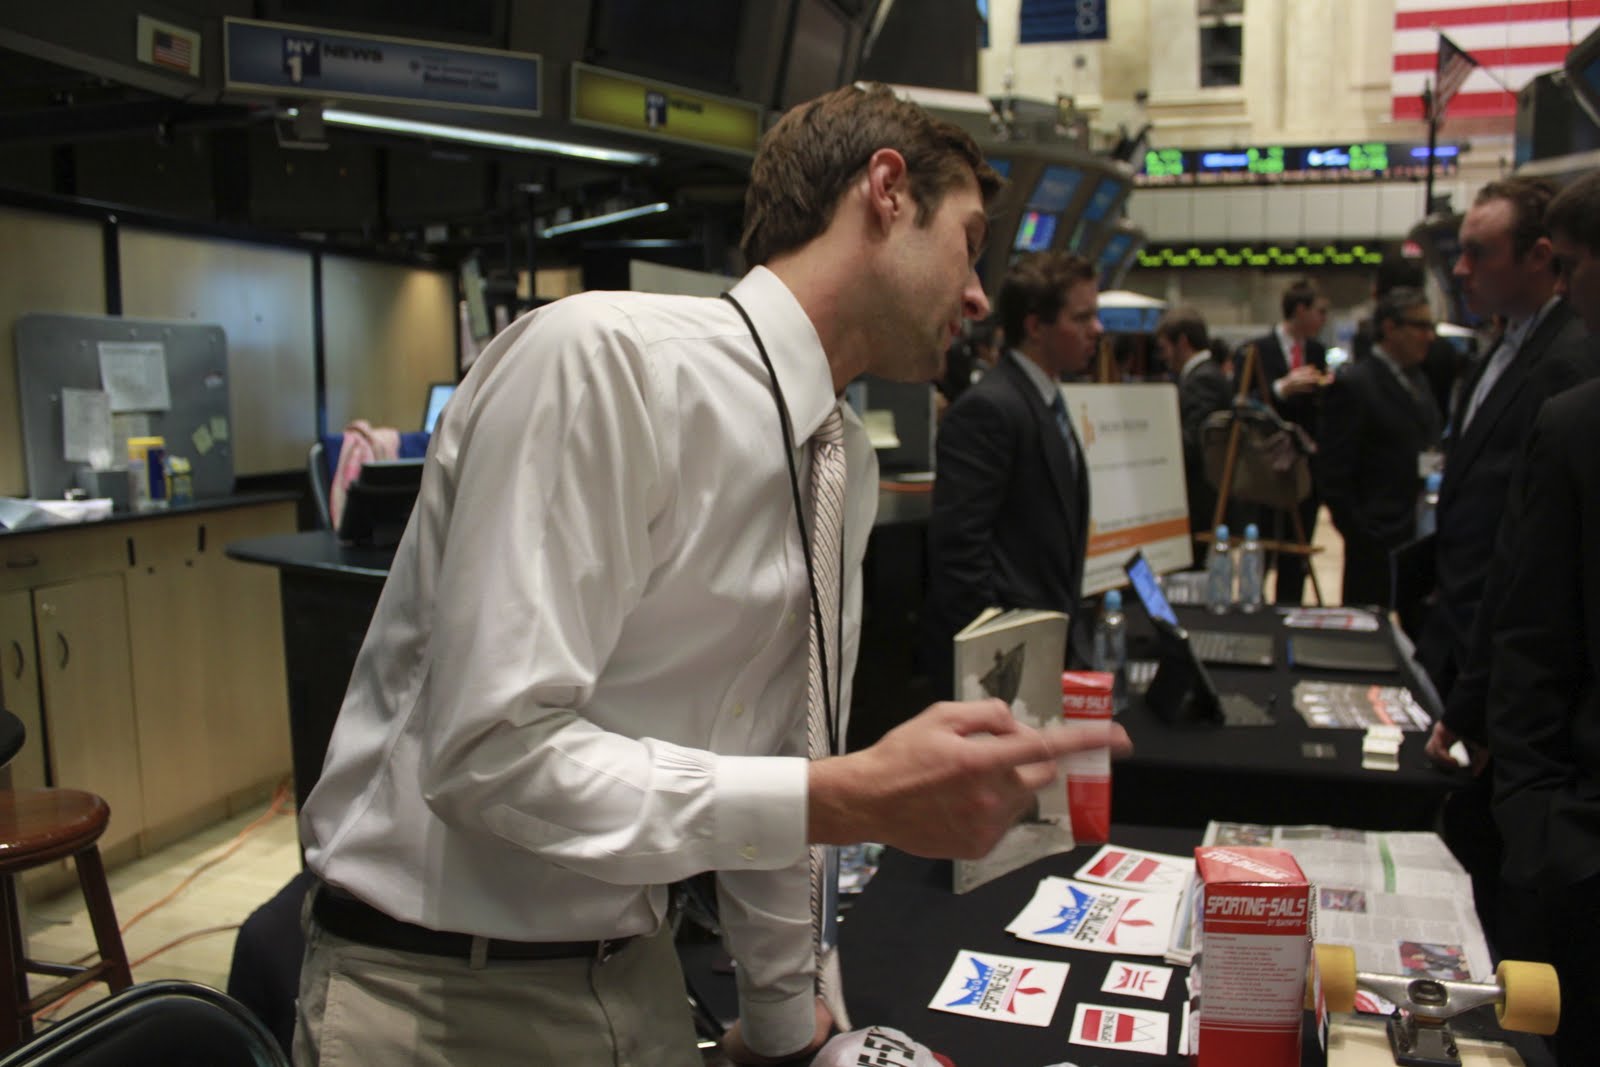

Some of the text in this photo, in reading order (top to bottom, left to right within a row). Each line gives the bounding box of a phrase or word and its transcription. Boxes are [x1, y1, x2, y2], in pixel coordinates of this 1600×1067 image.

[287, 39, 384, 62] NY NEWS
[287, 56, 302, 83] 1
[1205, 895, 1306, 916] SPORTING-SAILS
